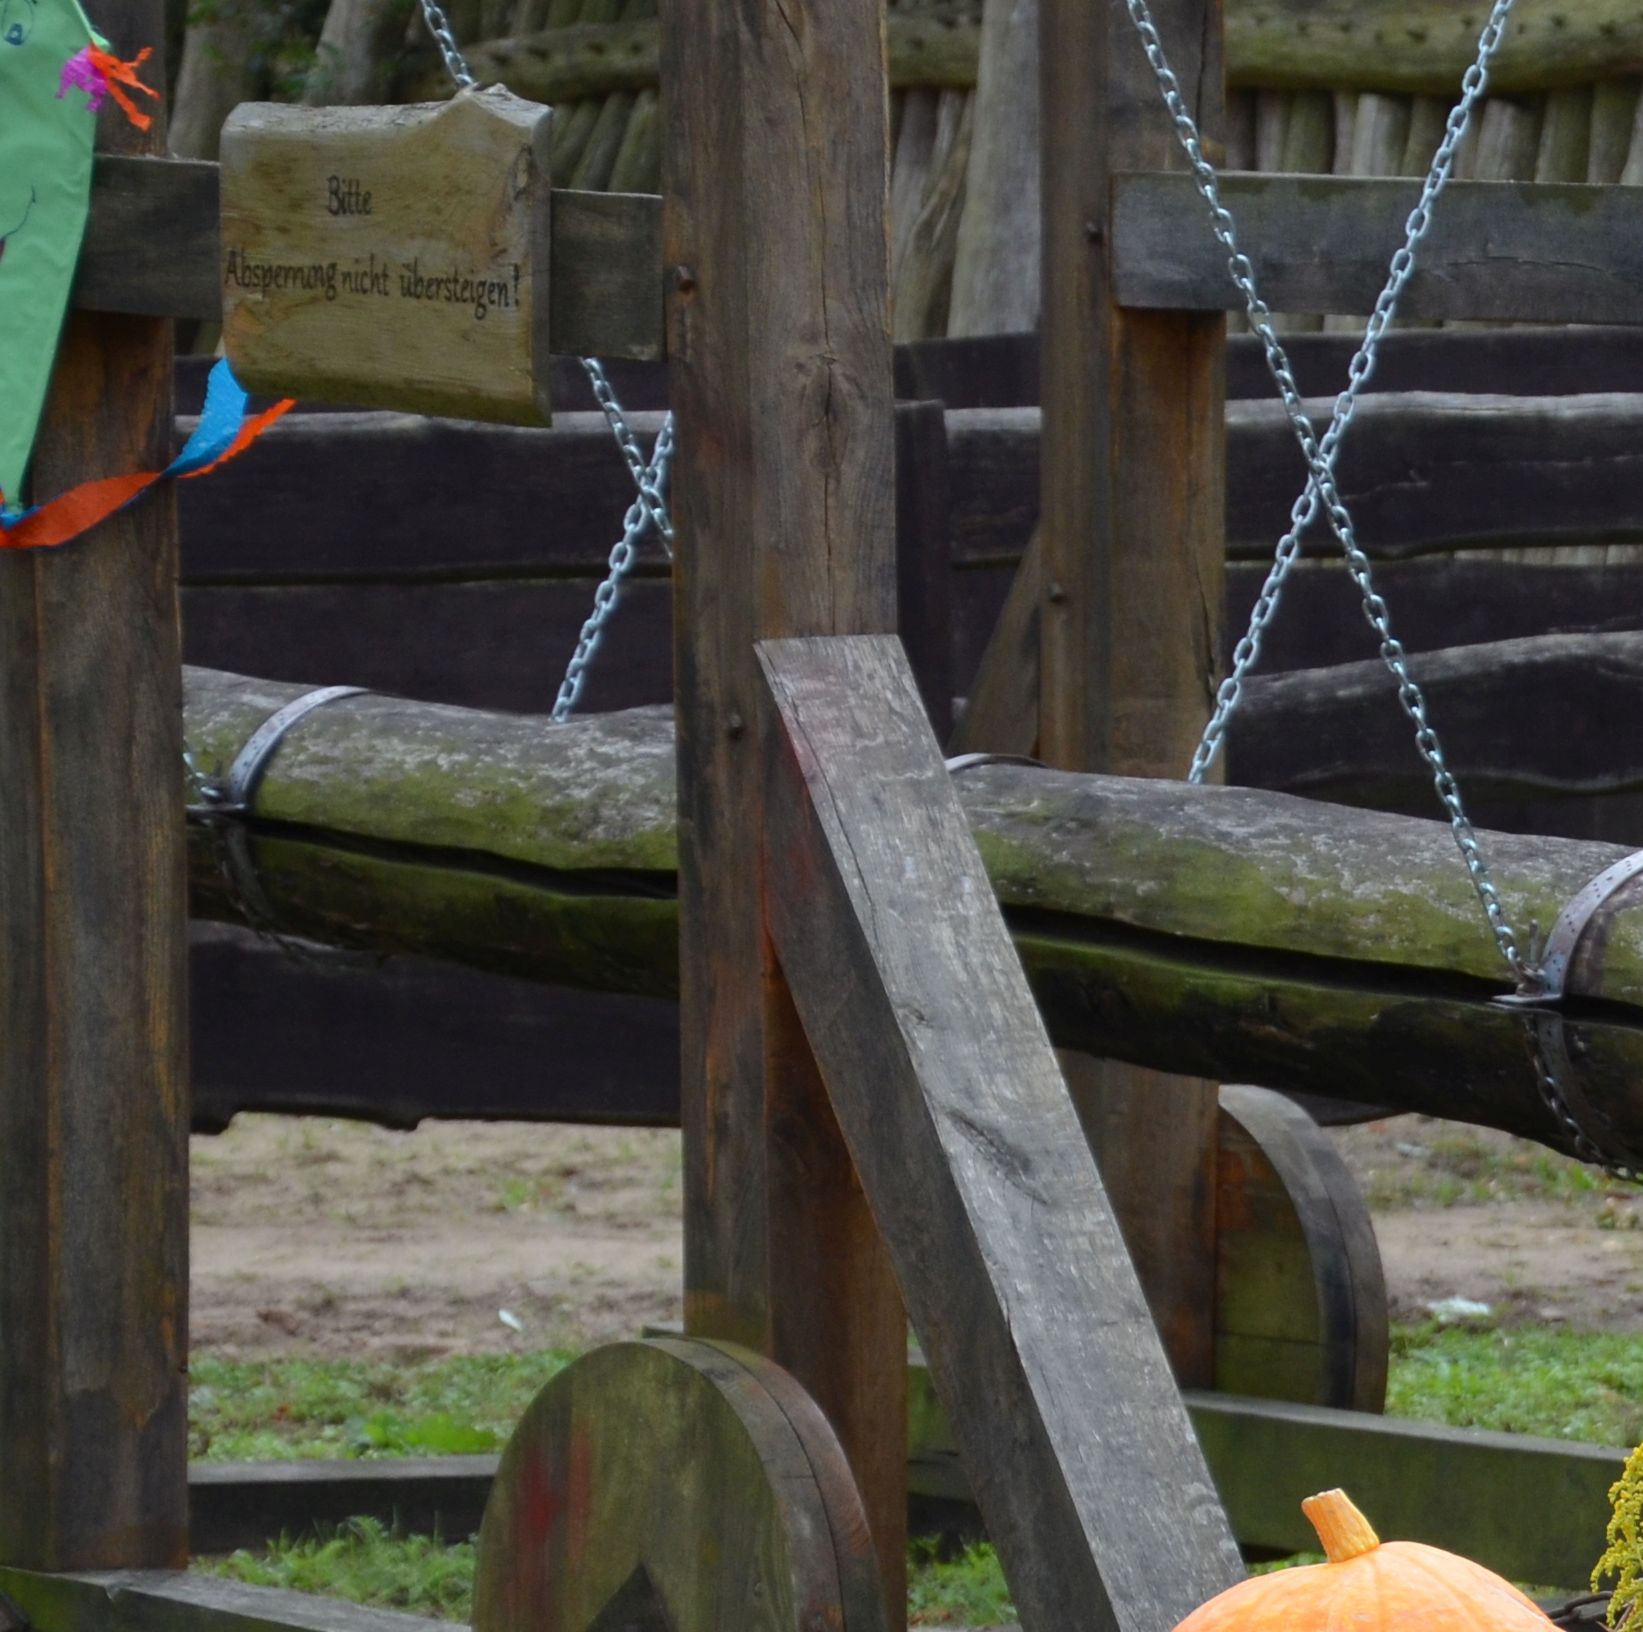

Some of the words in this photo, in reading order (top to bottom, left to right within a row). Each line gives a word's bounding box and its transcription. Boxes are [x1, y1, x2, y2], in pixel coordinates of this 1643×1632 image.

[326, 174, 373, 216] Bitte
[224, 248, 338, 302] Absperrung
[341, 252, 389, 296] nicht
[400, 256, 520, 320] übersteigen!
